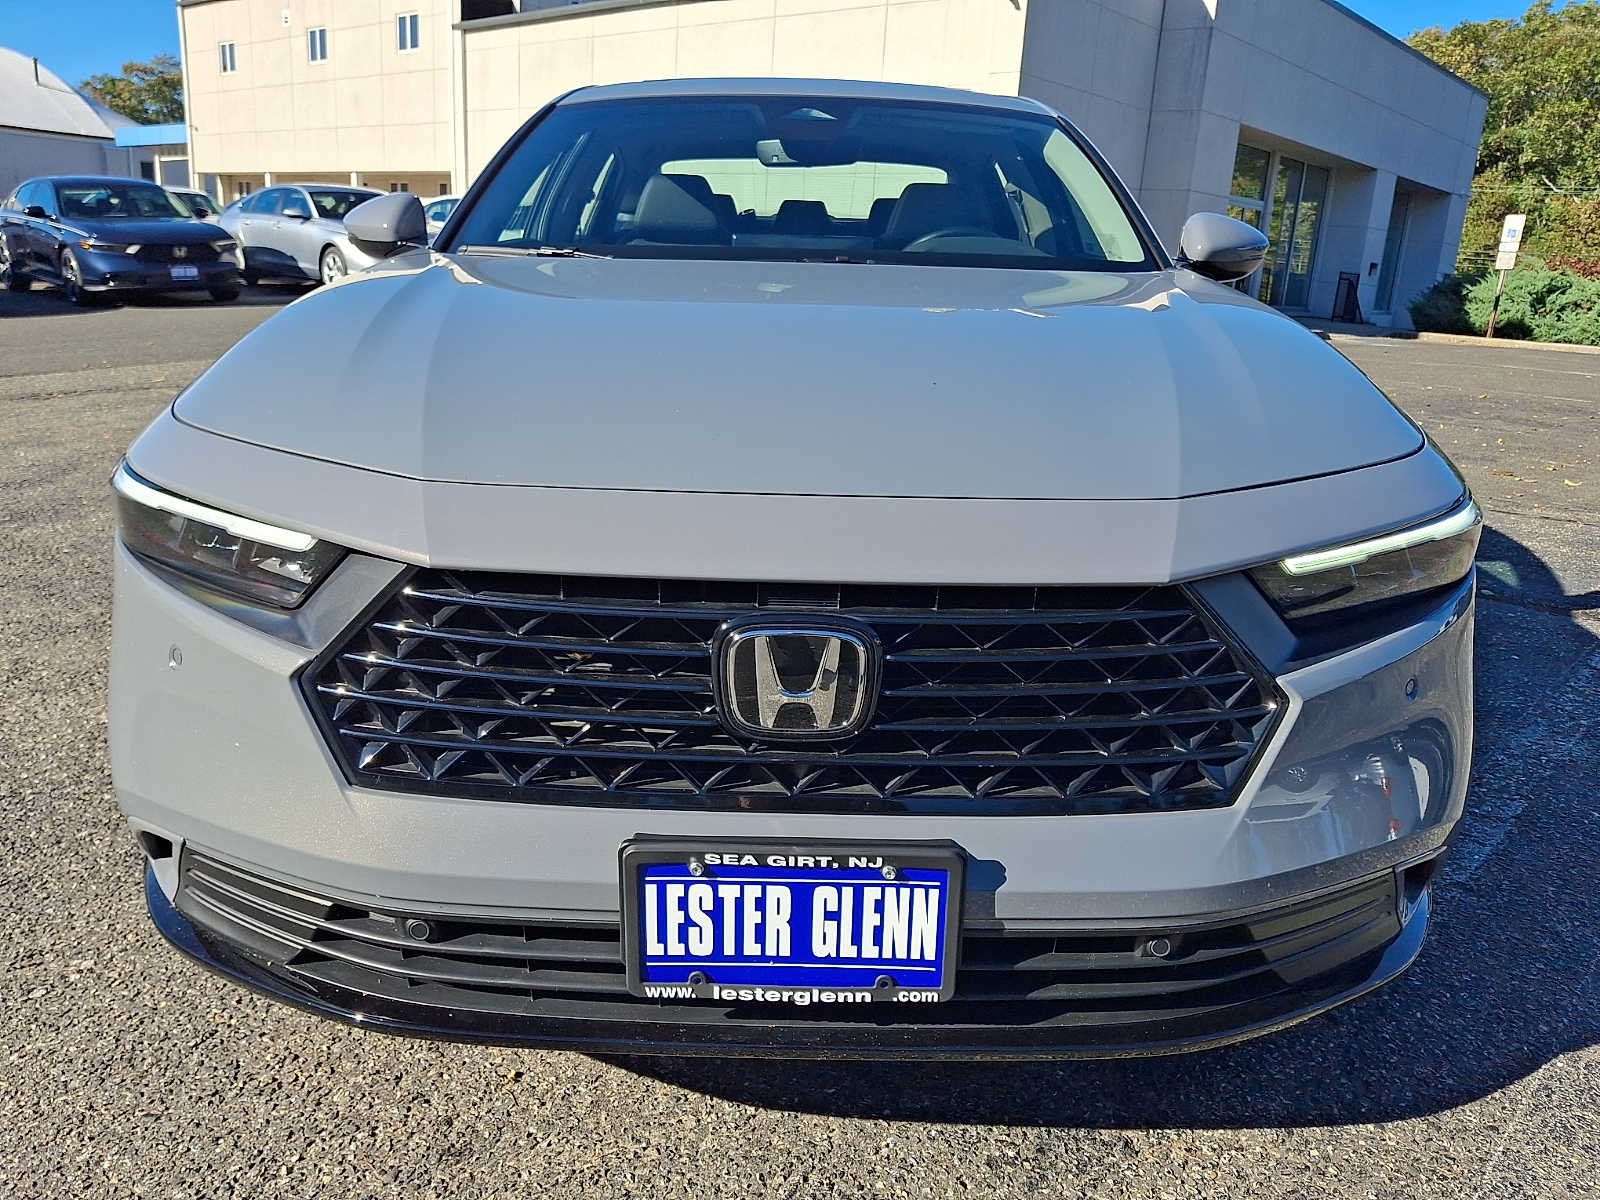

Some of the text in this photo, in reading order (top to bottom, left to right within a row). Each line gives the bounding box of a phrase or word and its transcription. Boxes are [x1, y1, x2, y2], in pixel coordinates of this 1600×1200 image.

[704, 853, 883, 869] SEA GIRT, NJ
[645, 883, 940, 961] LESTER GLENN
[644, 985, 939, 1006] www. lesterglenn .com
